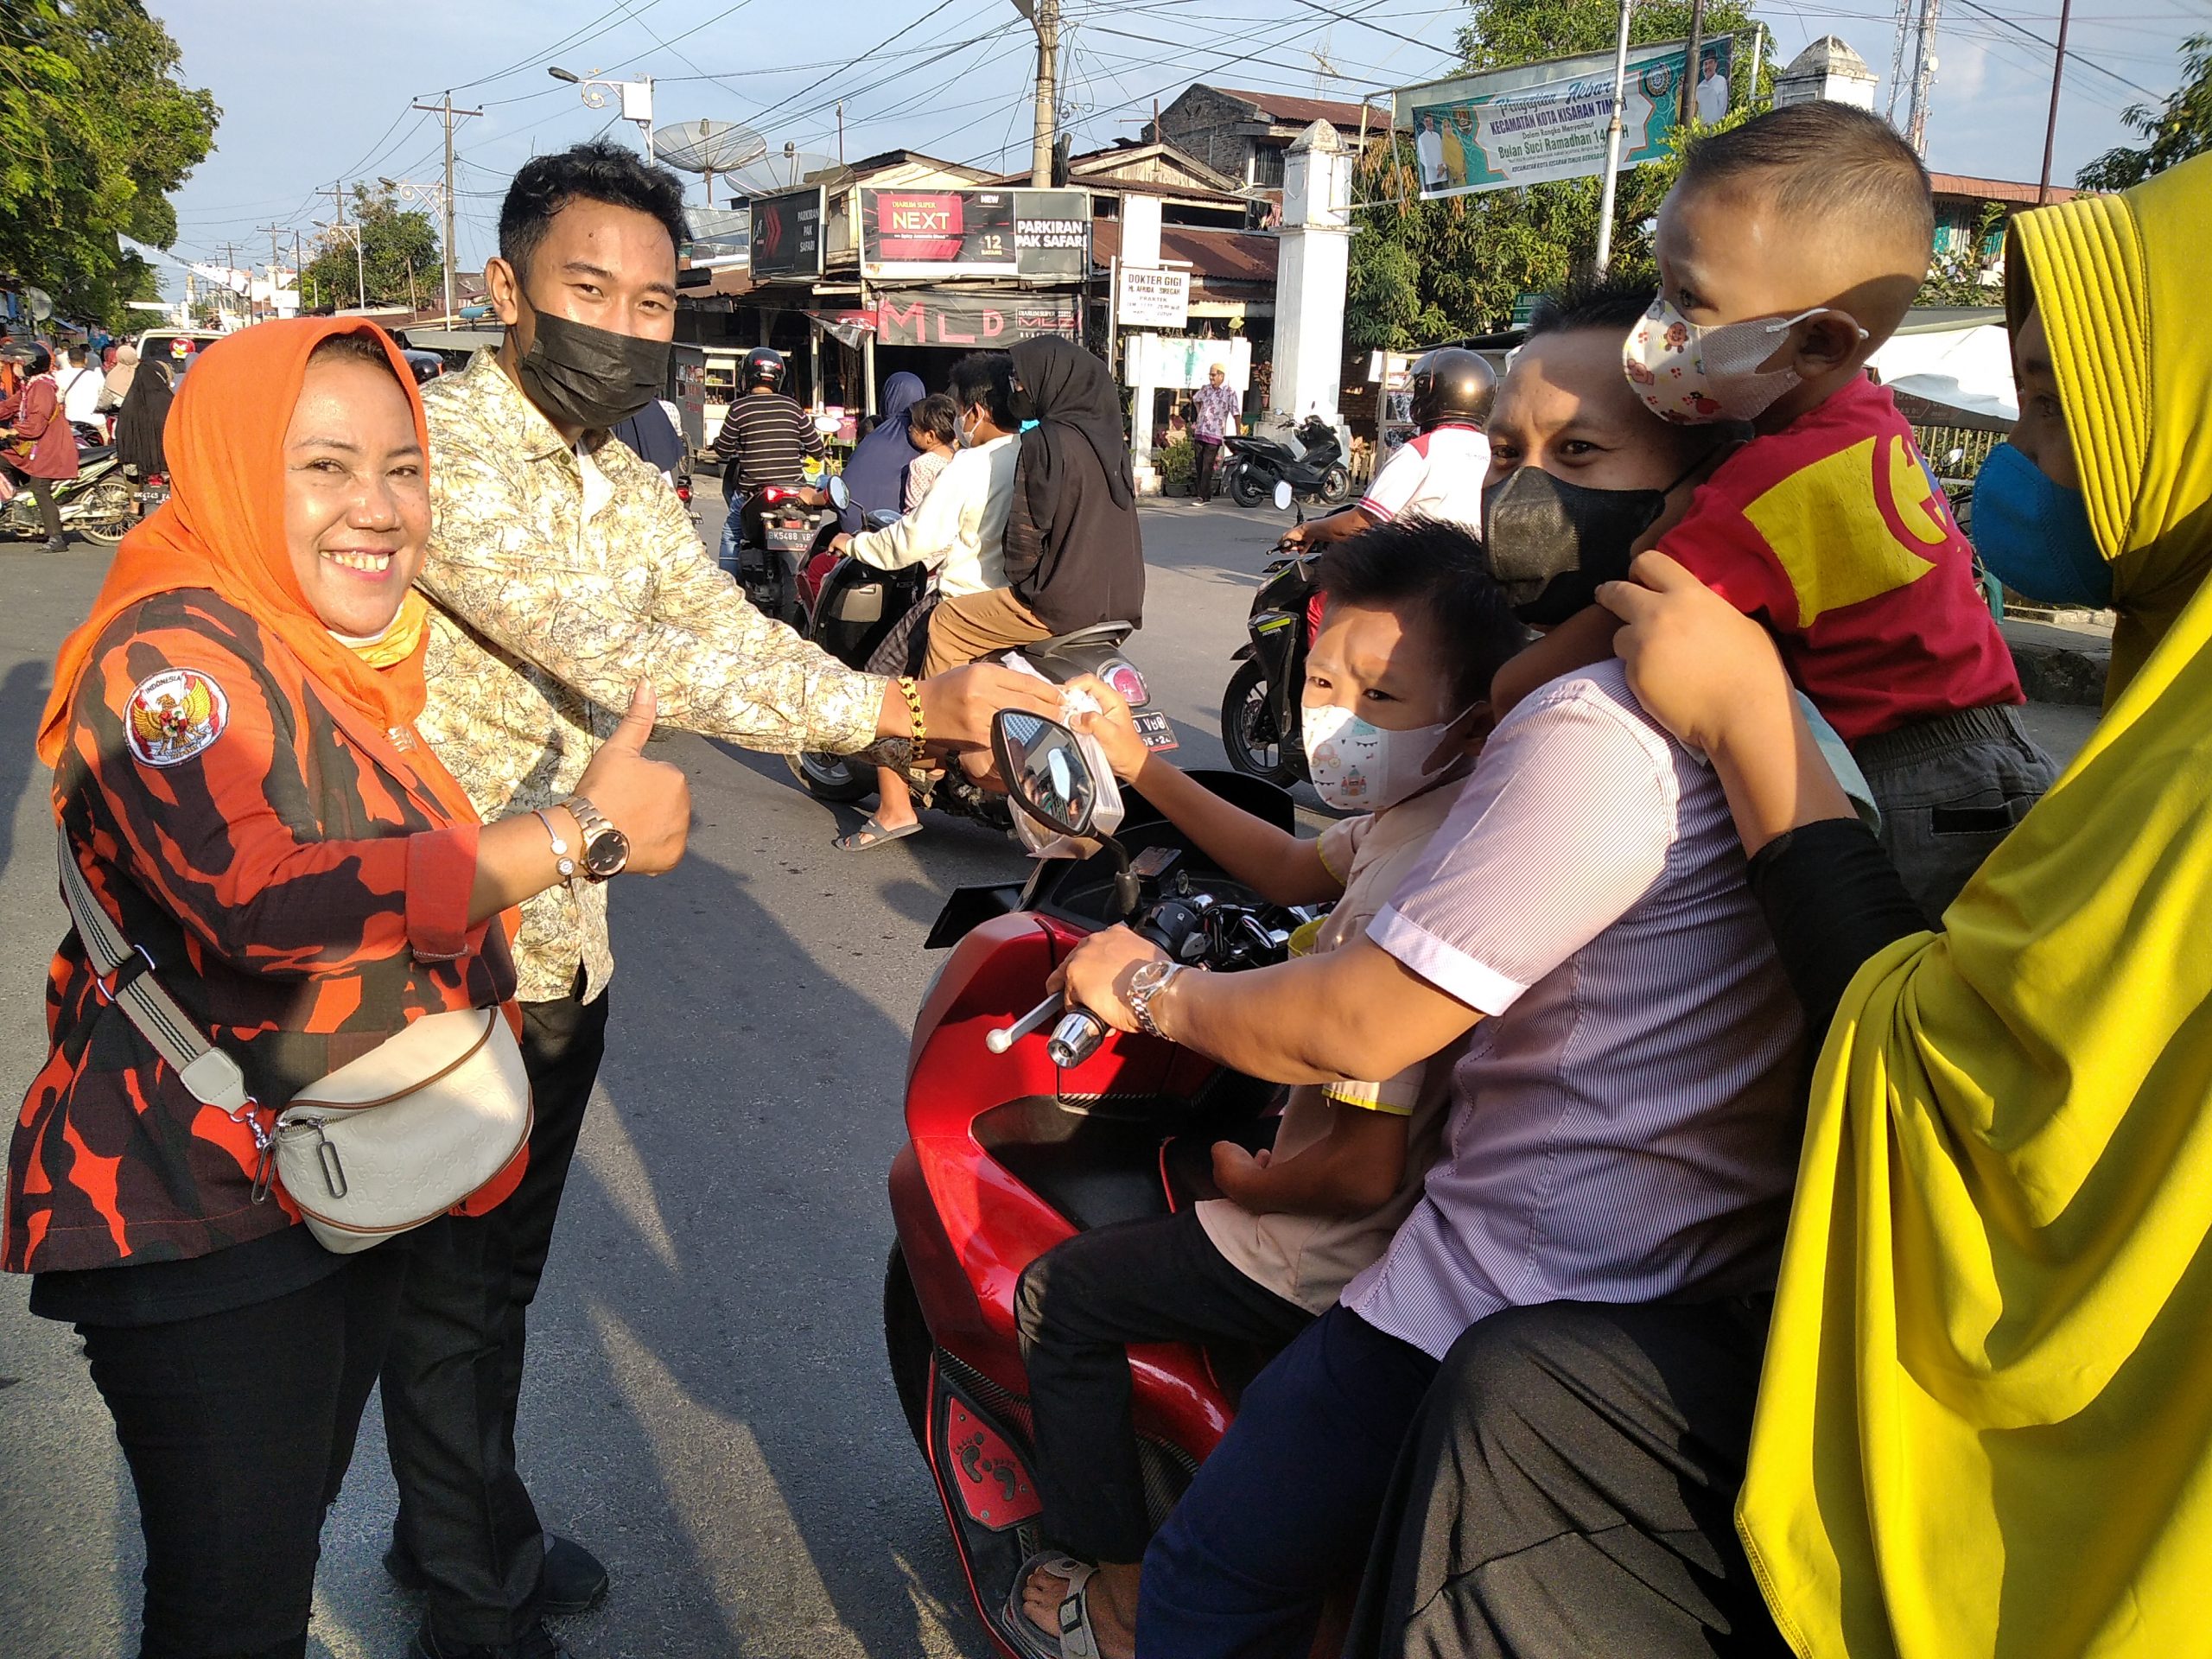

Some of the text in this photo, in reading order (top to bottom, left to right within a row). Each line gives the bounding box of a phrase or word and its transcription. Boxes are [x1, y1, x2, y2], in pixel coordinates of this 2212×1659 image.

[1565, 81, 1611, 105] Akbar
[1490, 96, 1628, 136] KECAMATAN KOTA KISARAN TIMR
[1541, 127, 1561, 137] Rangka
[1561, 121, 1594, 133] Menyambut
[1498, 145, 1522, 159] Bulan
[1524, 139, 1543, 155] Suci
[1545, 133, 1592, 151] Ramadhan
[981, 194, 1000, 204] NEW
[797, 207, 820, 222] PARKIRAN
[893, 212, 950, 230] NEXT
[803, 225, 812, 237] PAK
[1017, 220, 1083, 233] PARKIRAN
[799, 240, 816, 253] SAFARI
[984, 235, 1002, 249] 12
[1015, 234, 1087, 248] PAK SAFARI
[1128, 274, 1182, 287] DOKTER GIGI
[145, 675, 181, 695] INDONESIA
